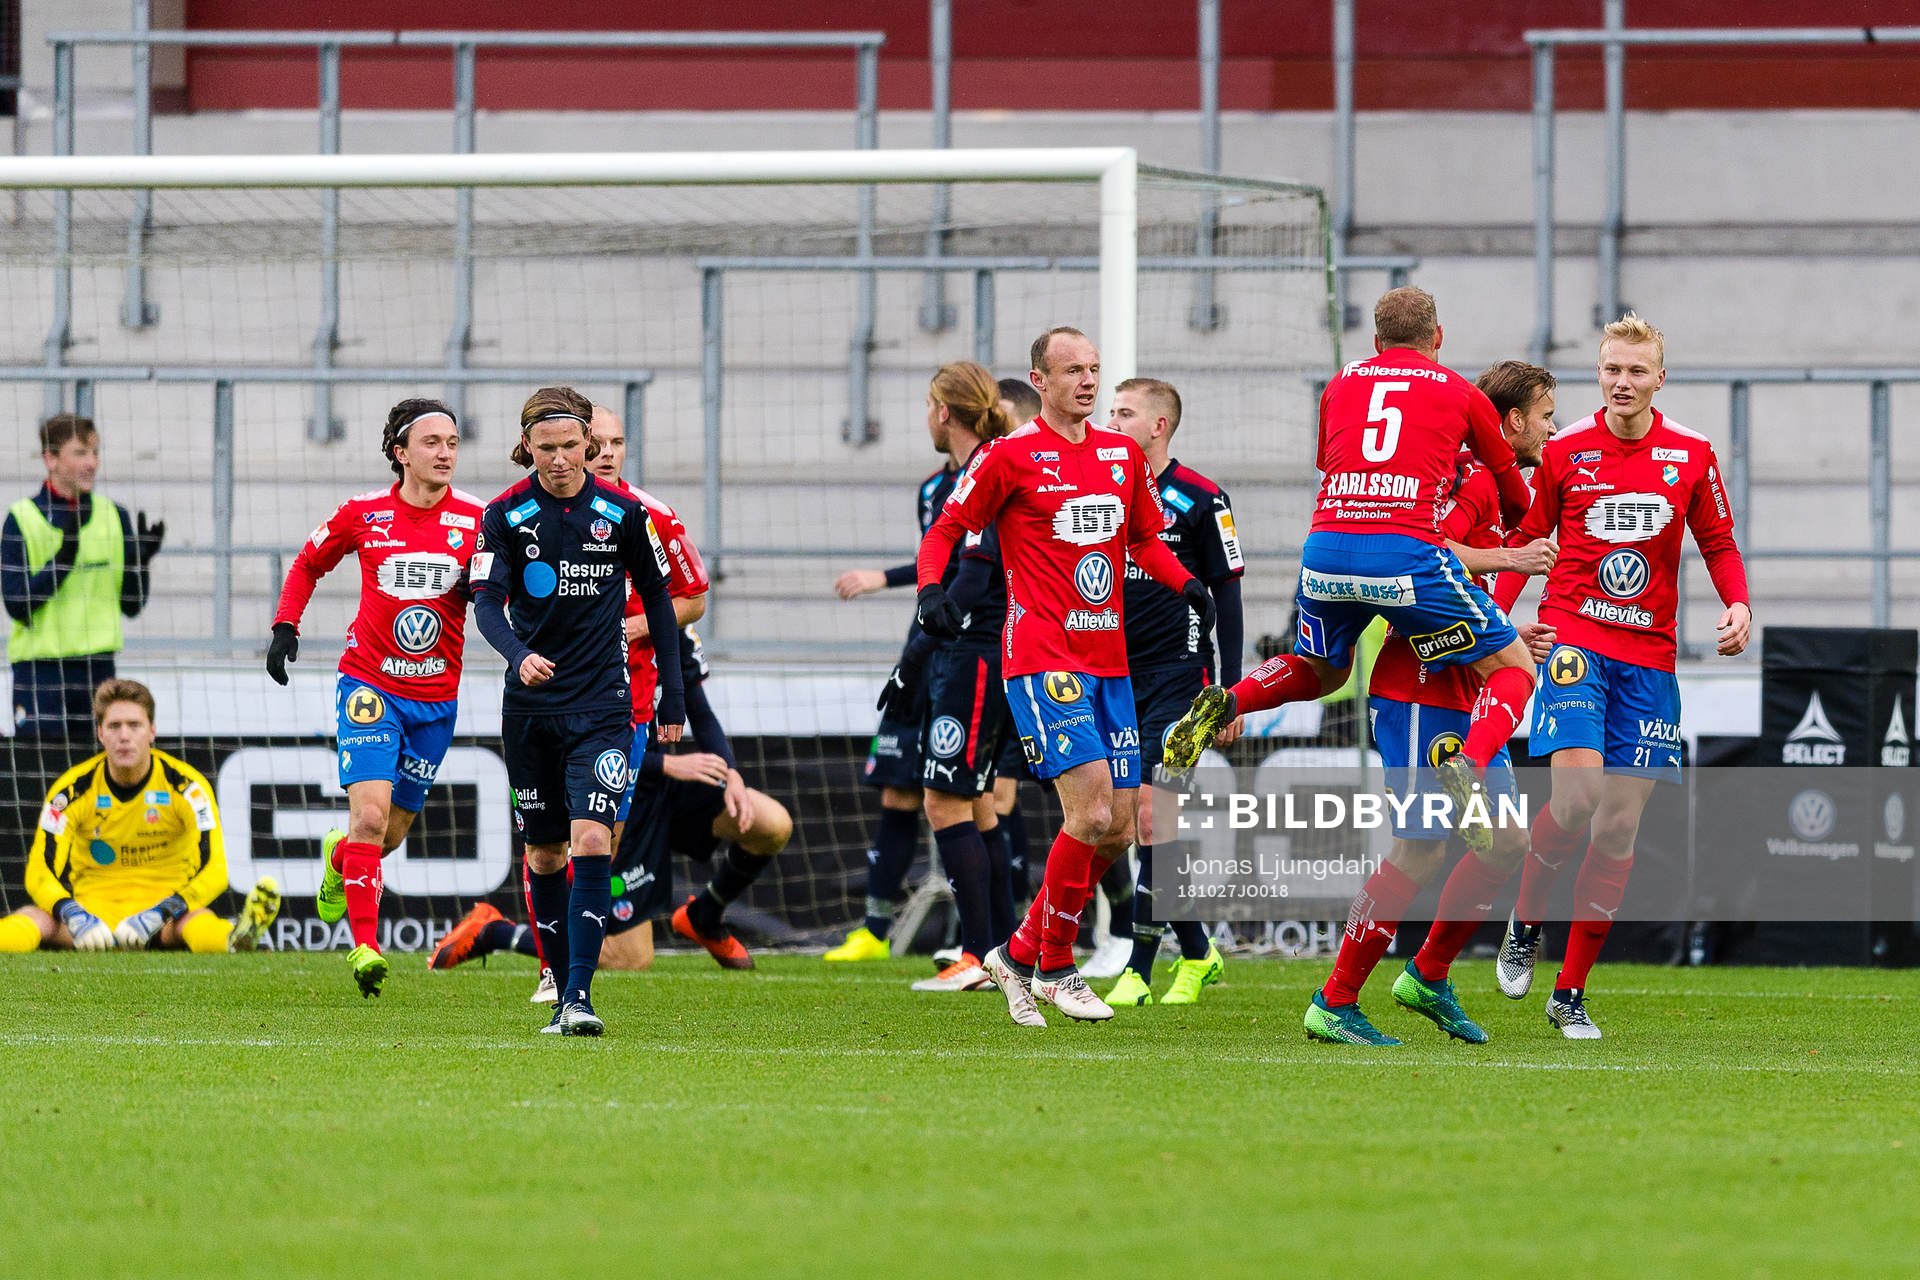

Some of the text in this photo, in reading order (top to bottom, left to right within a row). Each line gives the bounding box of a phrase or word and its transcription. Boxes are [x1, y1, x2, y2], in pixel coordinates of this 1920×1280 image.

[1361, 381, 1411, 463] 5
[1327, 473, 1420, 499] KARLSSON
[1336, 509, 1391, 519] Borgholm
[1345, 500, 1416, 510] Supermarket
[1713, 491, 1728, 519] DESIGN
[1071, 504, 1116, 533] IST
[1604, 503, 1660, 531] IST
[582, 542, 618, 552] stadium
[394, 561, 451, 590] IST
[559, 560, 614, 578] Resurs
[558, 580, 600, 596] Bank
[1064, 607, 1120, 631] Atteviks
[1579, 597, 1653, 628] Atteviks
[1418, 630, 1466, 657] griffel
[380, 655, 447, 677] Atteviks
[1633, 747, 1651, 768] 21
[1782, 743, 1846, 765] SELECT
[1112, 758, 1129, 778] 16
[587, 791, 608, 813] 15
[1767, 838, 1860, 860] Volkswagen
